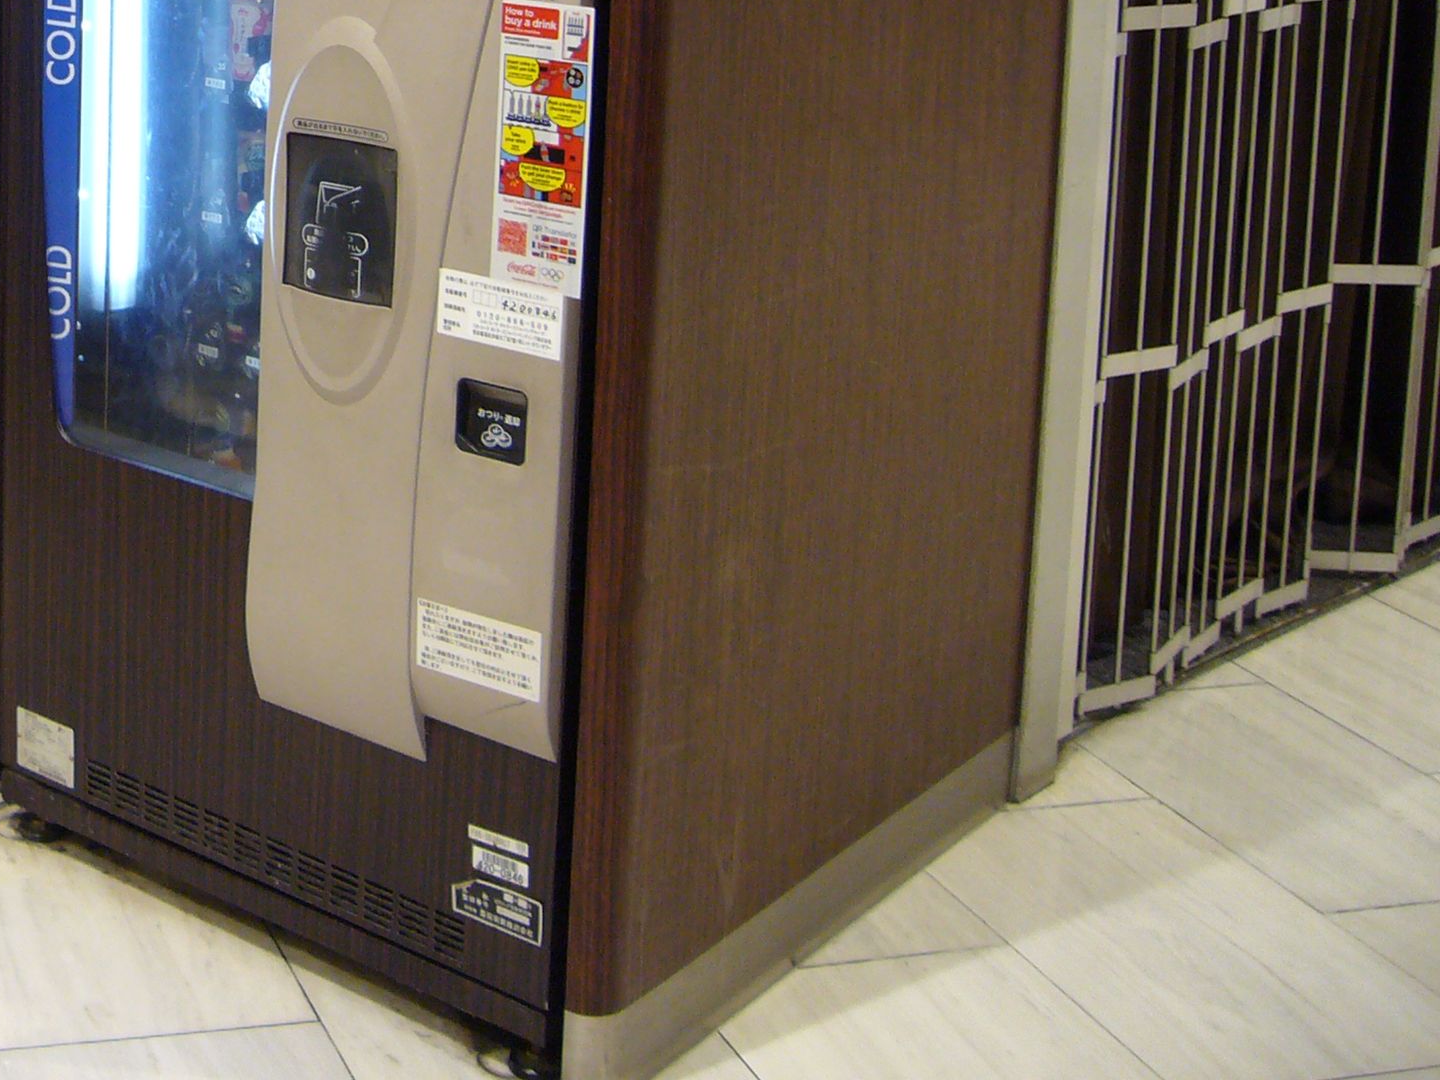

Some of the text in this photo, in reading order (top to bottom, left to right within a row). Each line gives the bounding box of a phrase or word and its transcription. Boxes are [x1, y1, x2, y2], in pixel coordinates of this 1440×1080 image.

[505, 6, 534, 17] How to
[504, 14, 523, 27] buy
[531, 18, 557, 30] drink
[46, 245, 73, 341] COLD
